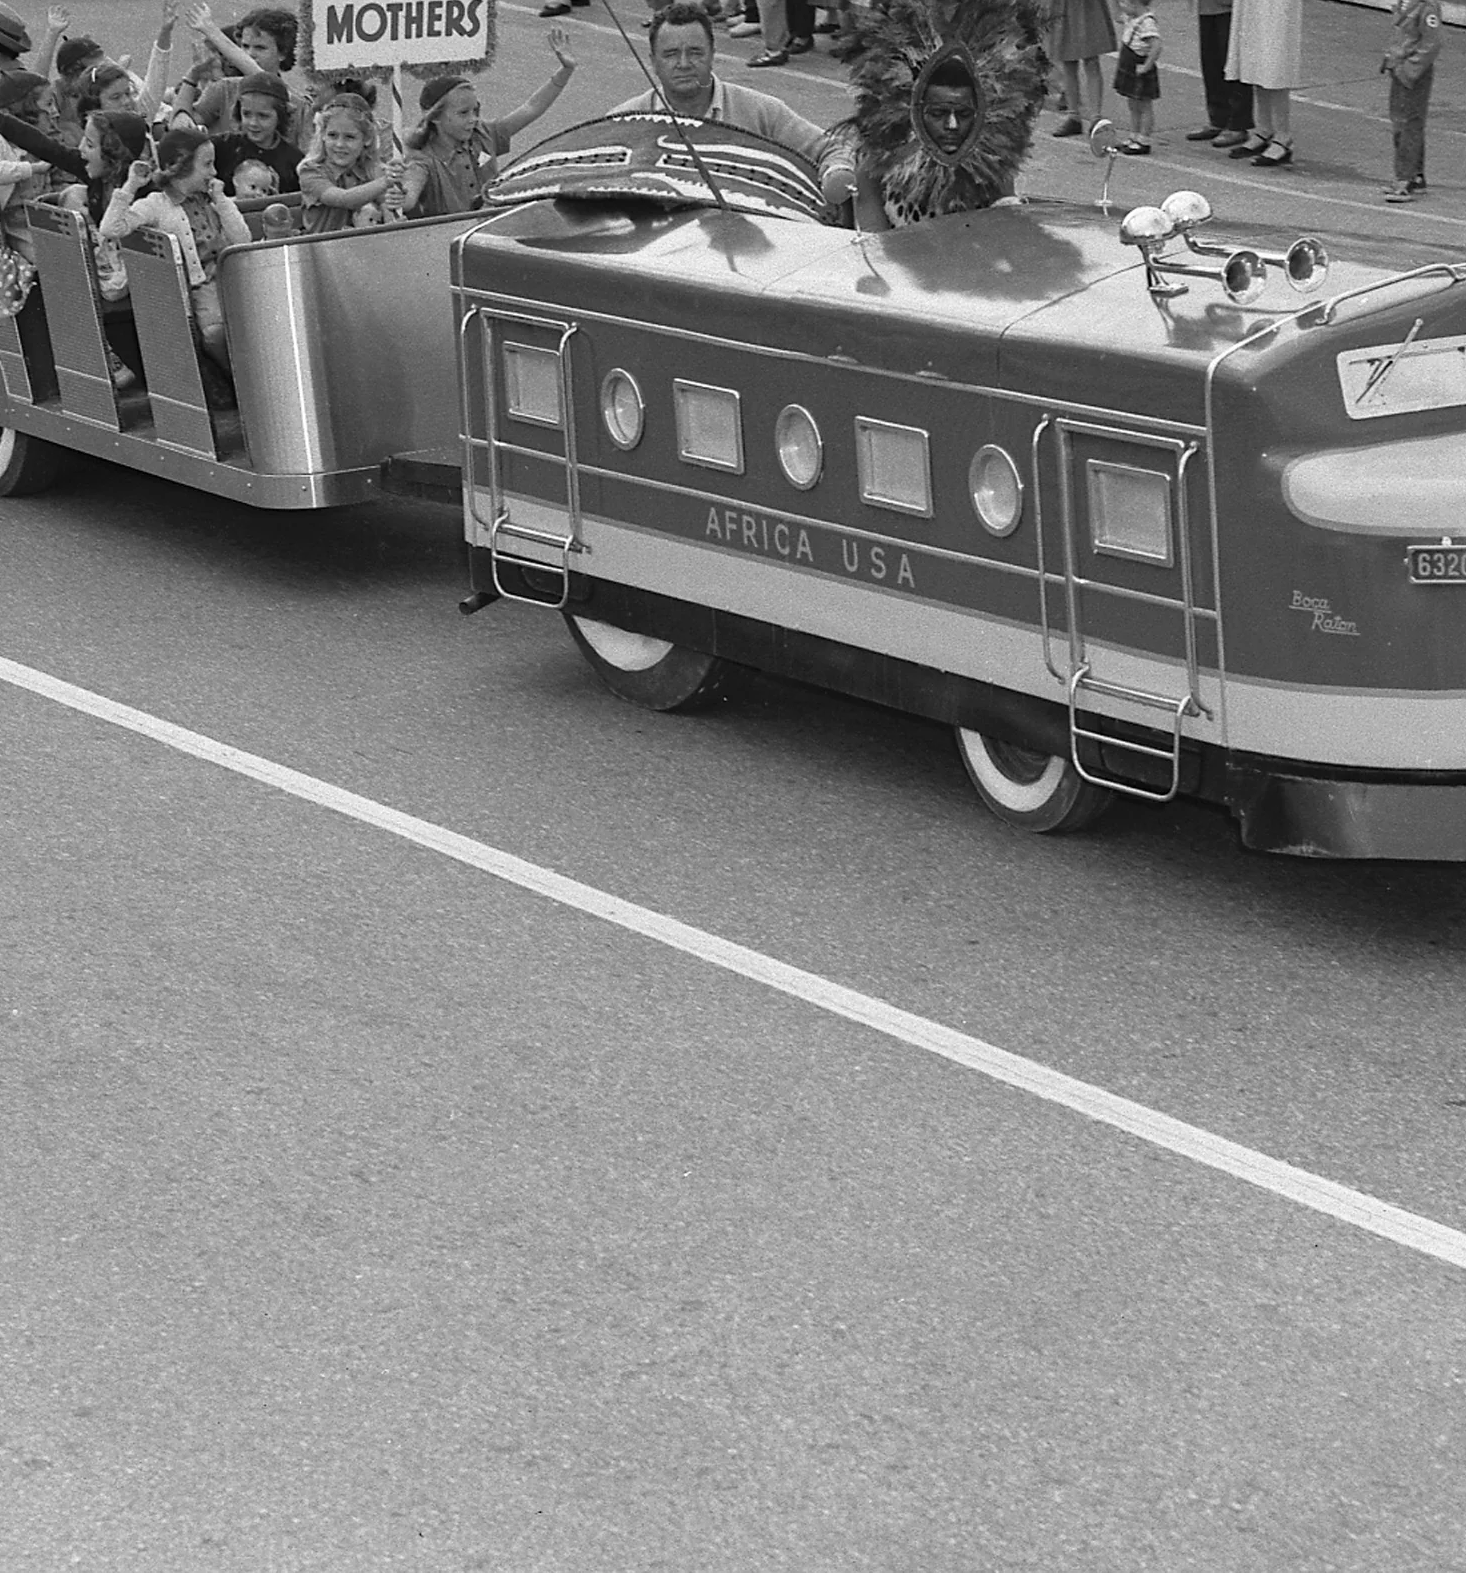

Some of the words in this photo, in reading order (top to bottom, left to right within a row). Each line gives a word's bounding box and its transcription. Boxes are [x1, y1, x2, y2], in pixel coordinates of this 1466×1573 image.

[706, 507, 813, 564] AFRICA
[842, 538, 917, 589] USA
[1291, 590, 1330, 610] Boca
[1312, 612, 1359, 634] Raton
